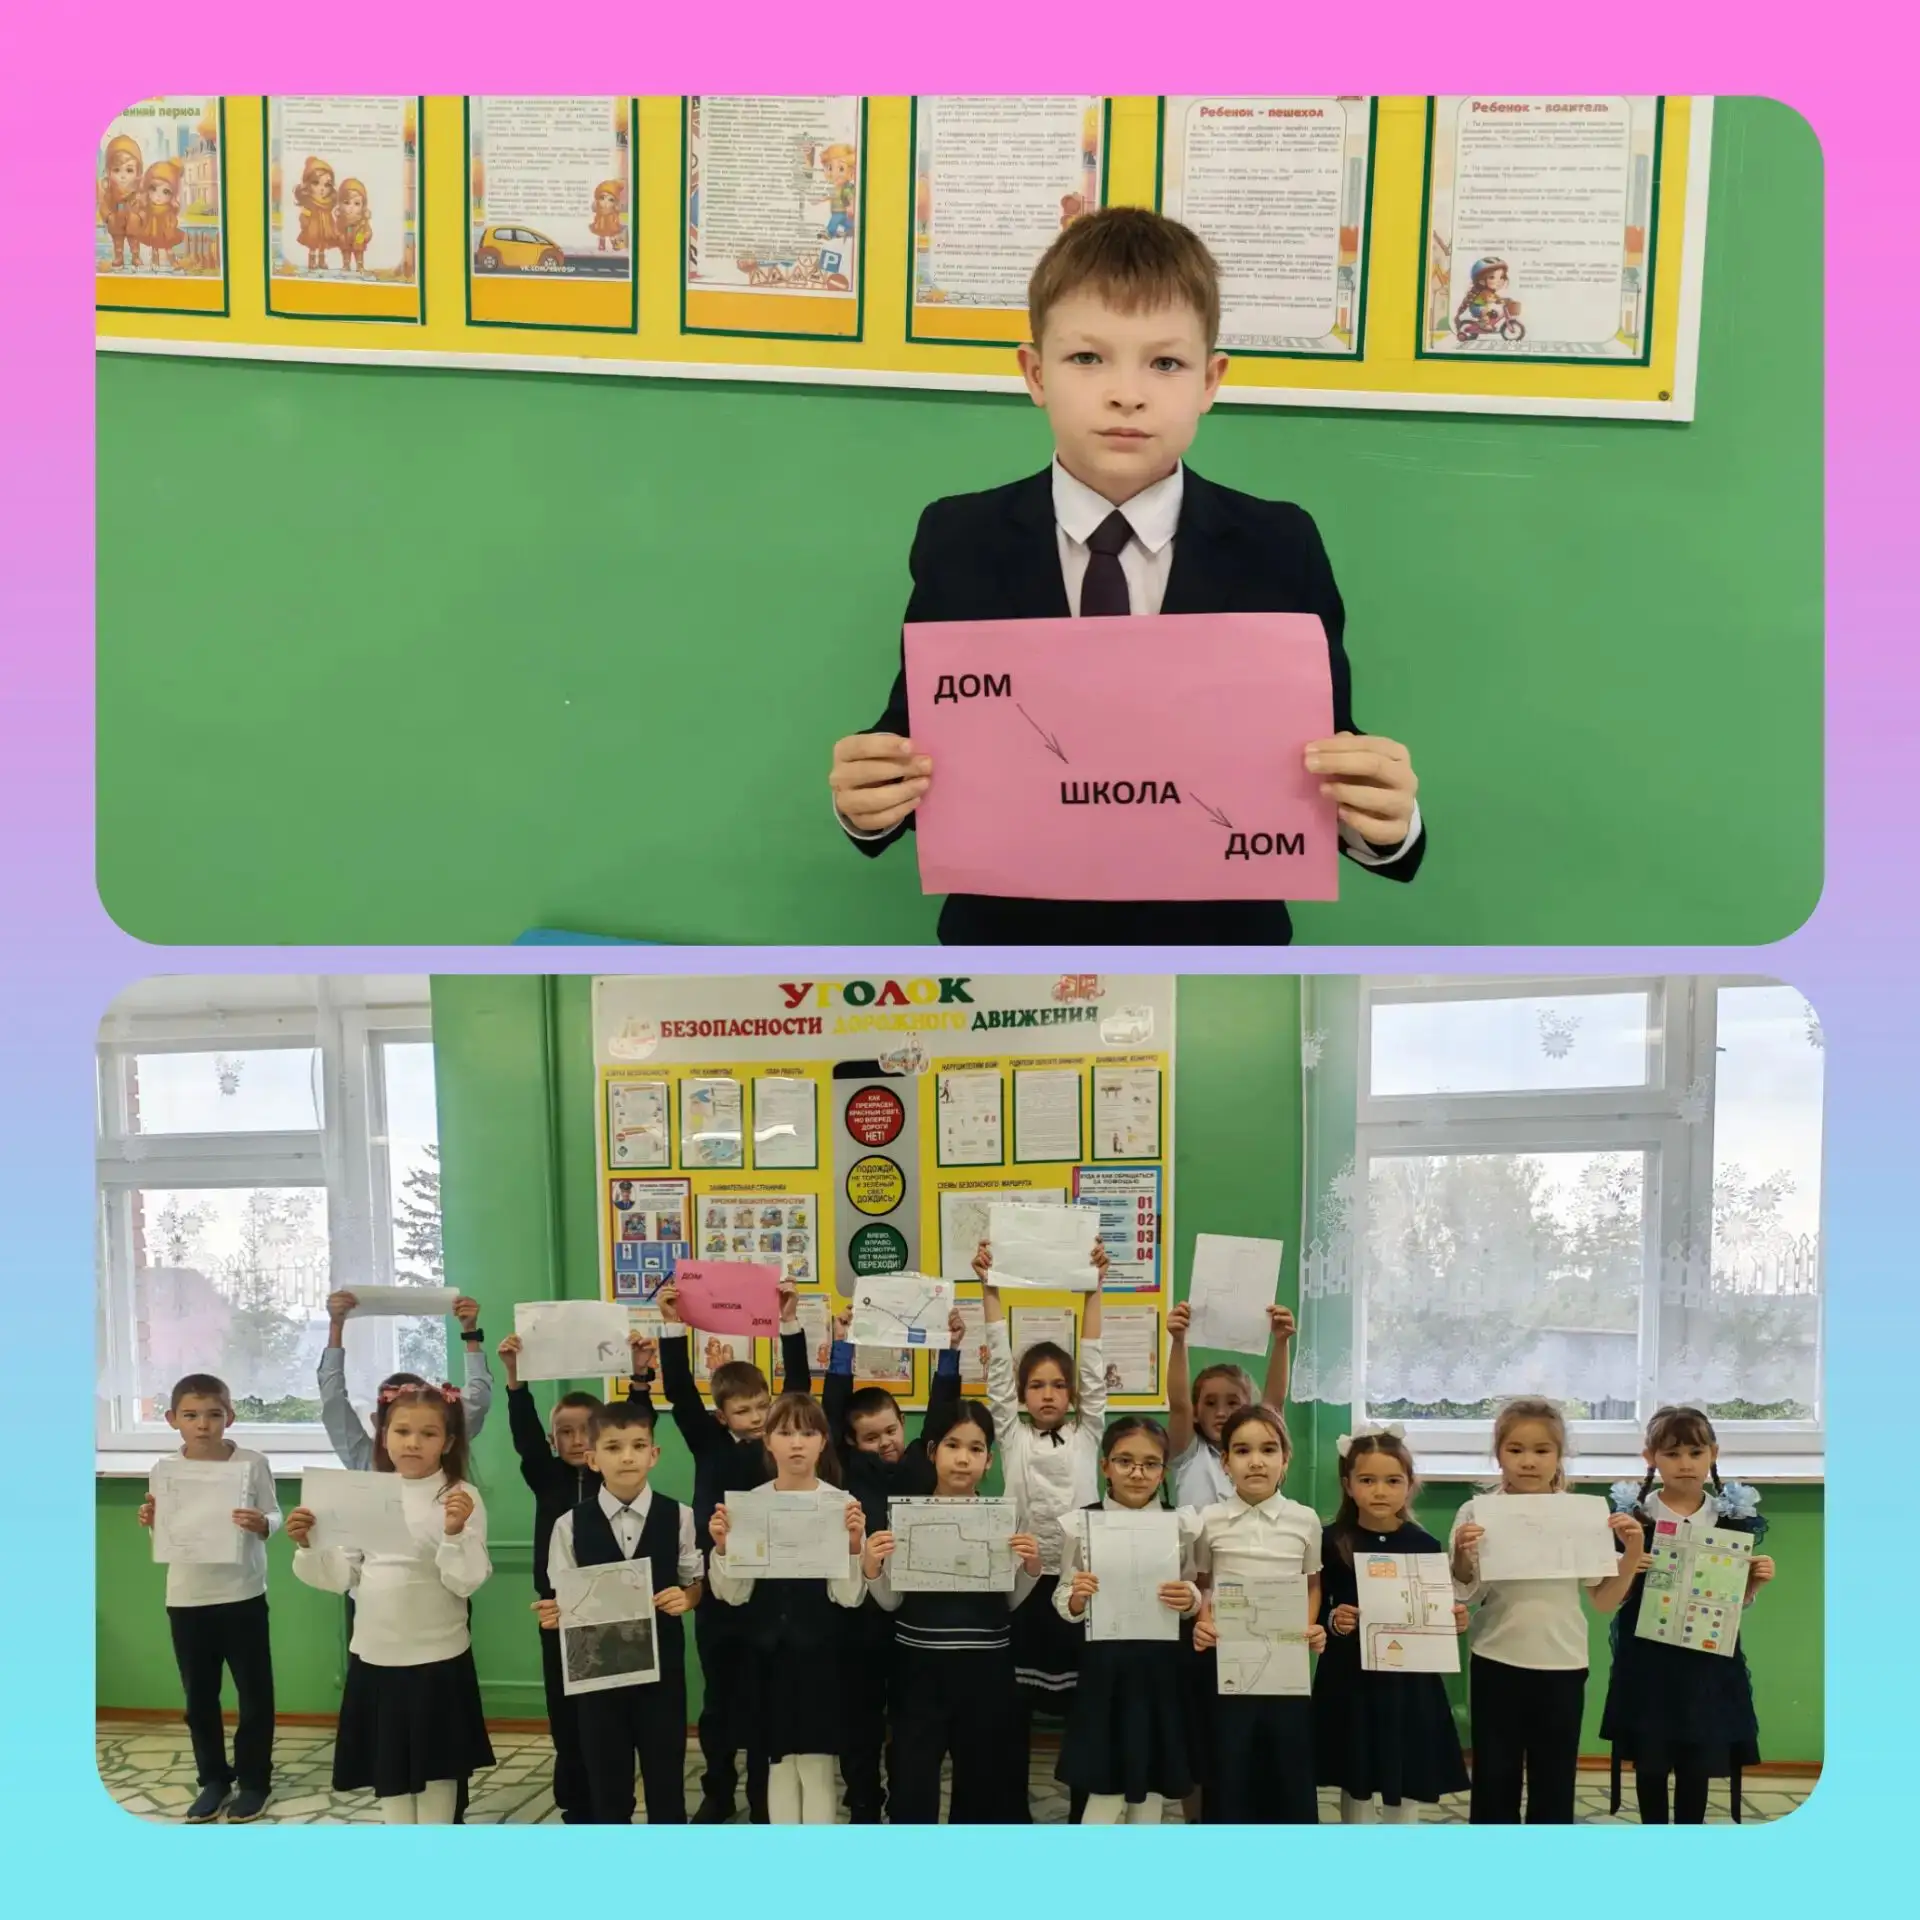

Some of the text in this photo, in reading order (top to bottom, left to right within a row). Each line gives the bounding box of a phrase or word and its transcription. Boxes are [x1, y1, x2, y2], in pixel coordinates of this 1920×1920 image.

[1200, 106, 1255, 118] Ребенок
[1268, 107, 1324, 118] пешеход
[1472, 101, 1530, 113] Ребенок
[1545, 102, 1609, 113] водитель
[934, 673, 1012, 704] ДОМ
[1060, 780, 1181, 805] ШКОЛА
[1225, 832, 1306, 860] ДОМ
[778, 977, 975, 1009] УГОЛОК
[660, 1006, 1099, 1039] БЕЗОПАСНОСТИ ДОРОЖНОГО ДВИЖЕНИЯ
[861, 1123, 889, 1131] ДОРОГИ
[865, 1131, 885, 1141] НЕТ!
[856, 1164, 894, 1174] ПОДОЖДИ
[856, 1194, 896, 1204] ДОЖДИСЬ!
[1137, 1196, 1153, 1209] 01
[1137, 1213, 1154, 1226] 02
[1137, 1230, 1154, 1243] 03
[1137, 1247, 1154, 1260] 04
[858, 1260, 901, 1270] ПЕРЕХОДИ!
[681, 1272, 703, 1281] ДОМ
[711, 1302, 742, 1310] ШКОЛА
[752, 1318, 772, 1326] ДОМ
